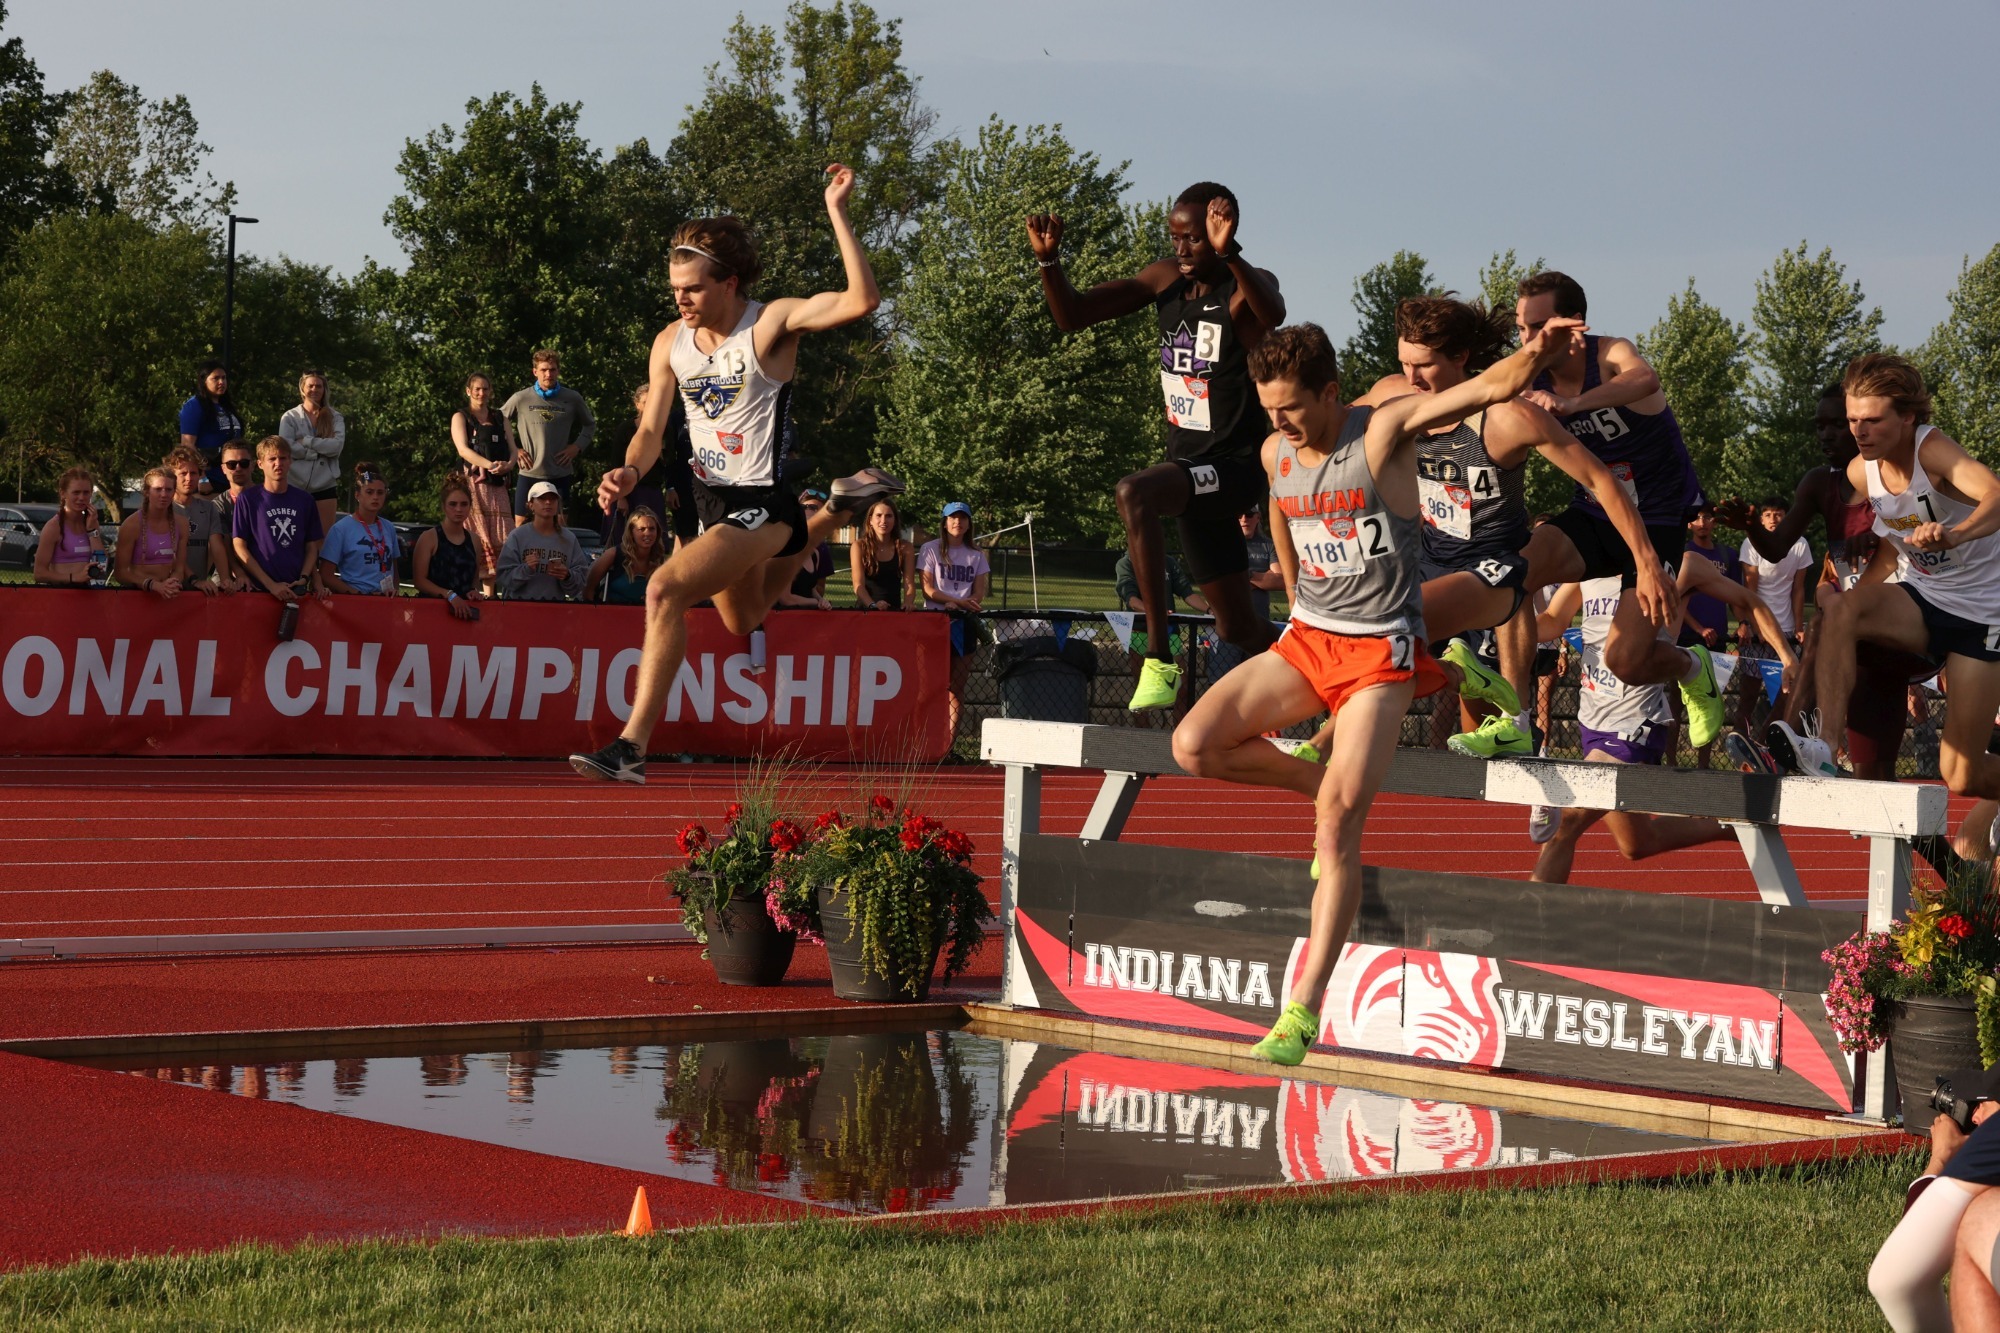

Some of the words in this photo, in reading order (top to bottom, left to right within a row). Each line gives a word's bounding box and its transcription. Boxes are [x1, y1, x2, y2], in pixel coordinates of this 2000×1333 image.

[1199, 324, 1215, 358] 3
[722, 348, 746, 375] 13
[1172, 348, 1194, 373] G
[1170, 394, 1195, 416] 987
[1596, 409, 1621, 438] 5
[699, 447, 726, 471] 966
[1193, 470, 1217, 488] 3
[1474, 470, 1494, 498] 4
[266, 508, 297, 518] GOSHEN
[1277, 488, 1366, 517] MILLIGAN
[1427, 497, 1455, 522] 961
[1917, 494, 1937, 522] 7
[1363, 518, 1388, 556] 2
[1304, 541, 1348, 563] 1181
[1395, 635, 1411, 670] 2
[1, 635, 232, 717] ONAL
[1586, 664, 1617, 689] 1425
[1084, 942, 1275, 1008] INDIANA
[1499, 988, 1778, 1070] WESLEYAN
